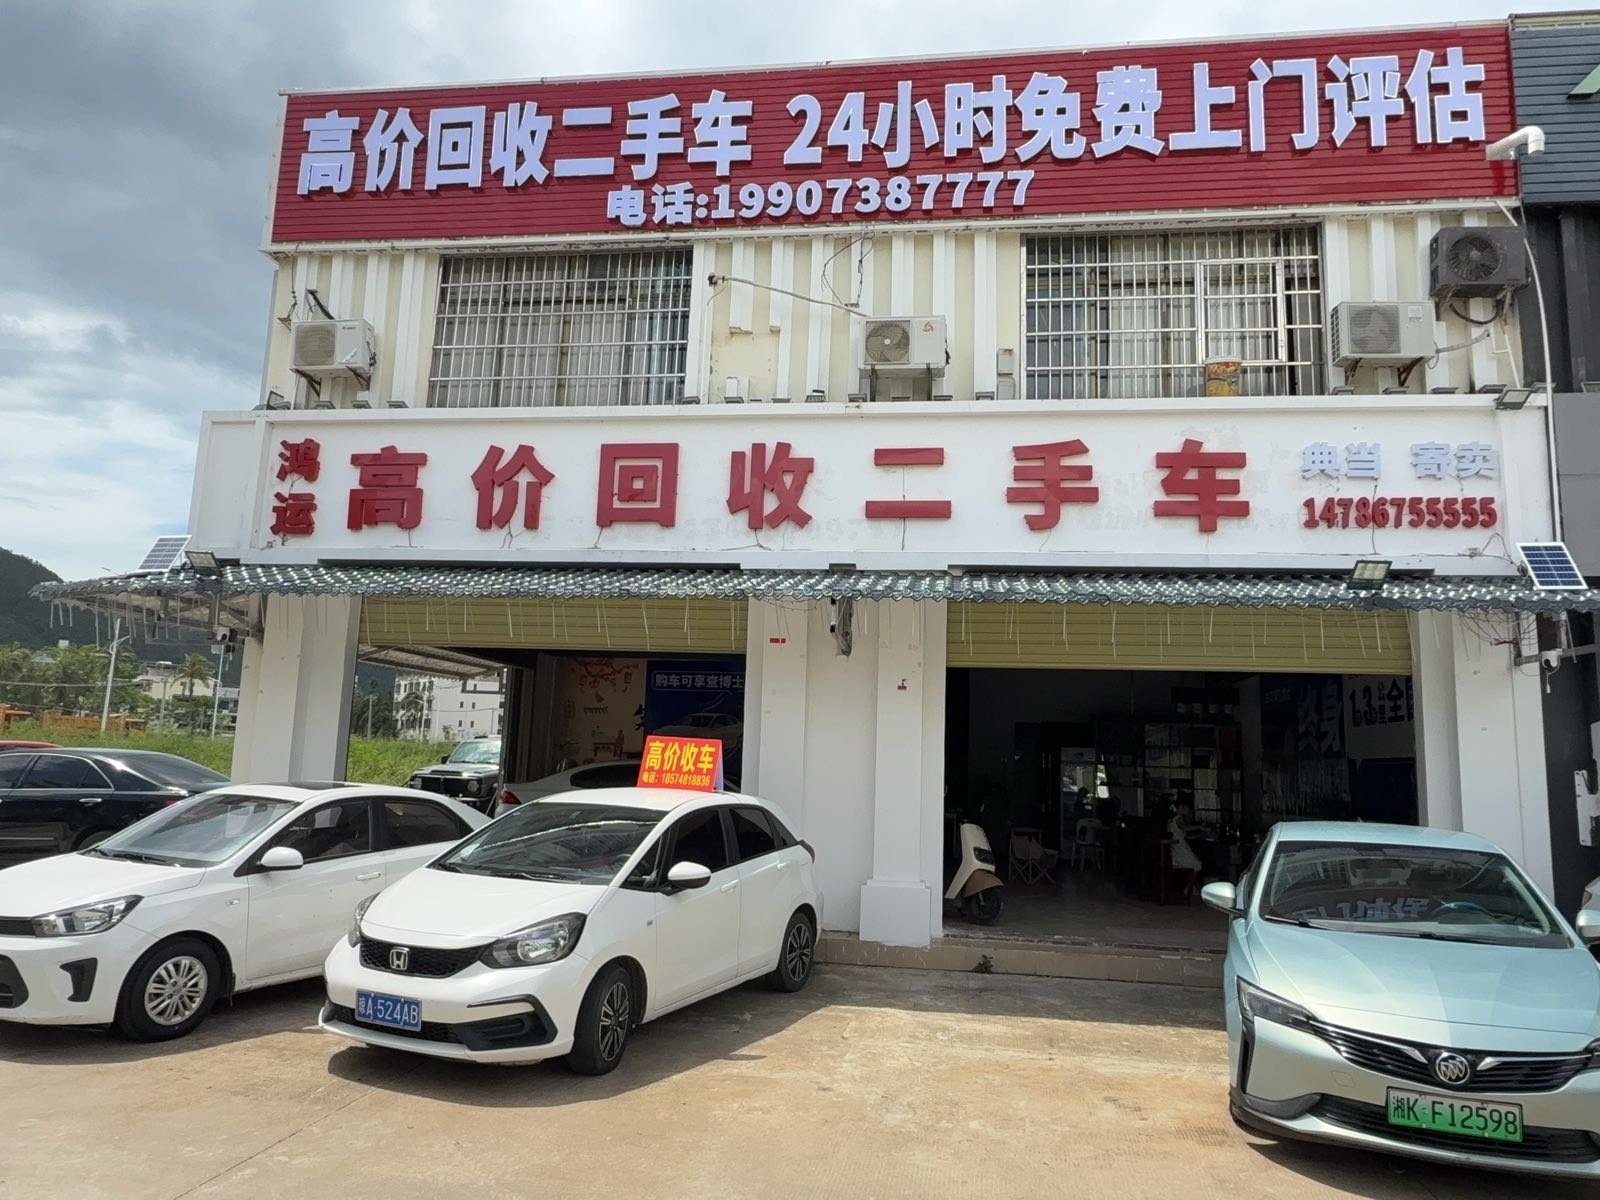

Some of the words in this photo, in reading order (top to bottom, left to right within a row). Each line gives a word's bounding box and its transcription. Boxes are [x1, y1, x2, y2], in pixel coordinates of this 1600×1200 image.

[297, 88, 753, 196] 高价回收二手车
[782, 45, 1487, 169] 24小时免费上门评估
[269, 438, 321, 536] 鸿运
[346, 440, 1250, 532] 高价回收二手车
[1301, 441, 1382, 481] 典当
[1410, 441, 1498, 481] 寄卖
[1303, 497, 1497, 528] 14786755555
[644, 740, 717, 774] 高价收车
